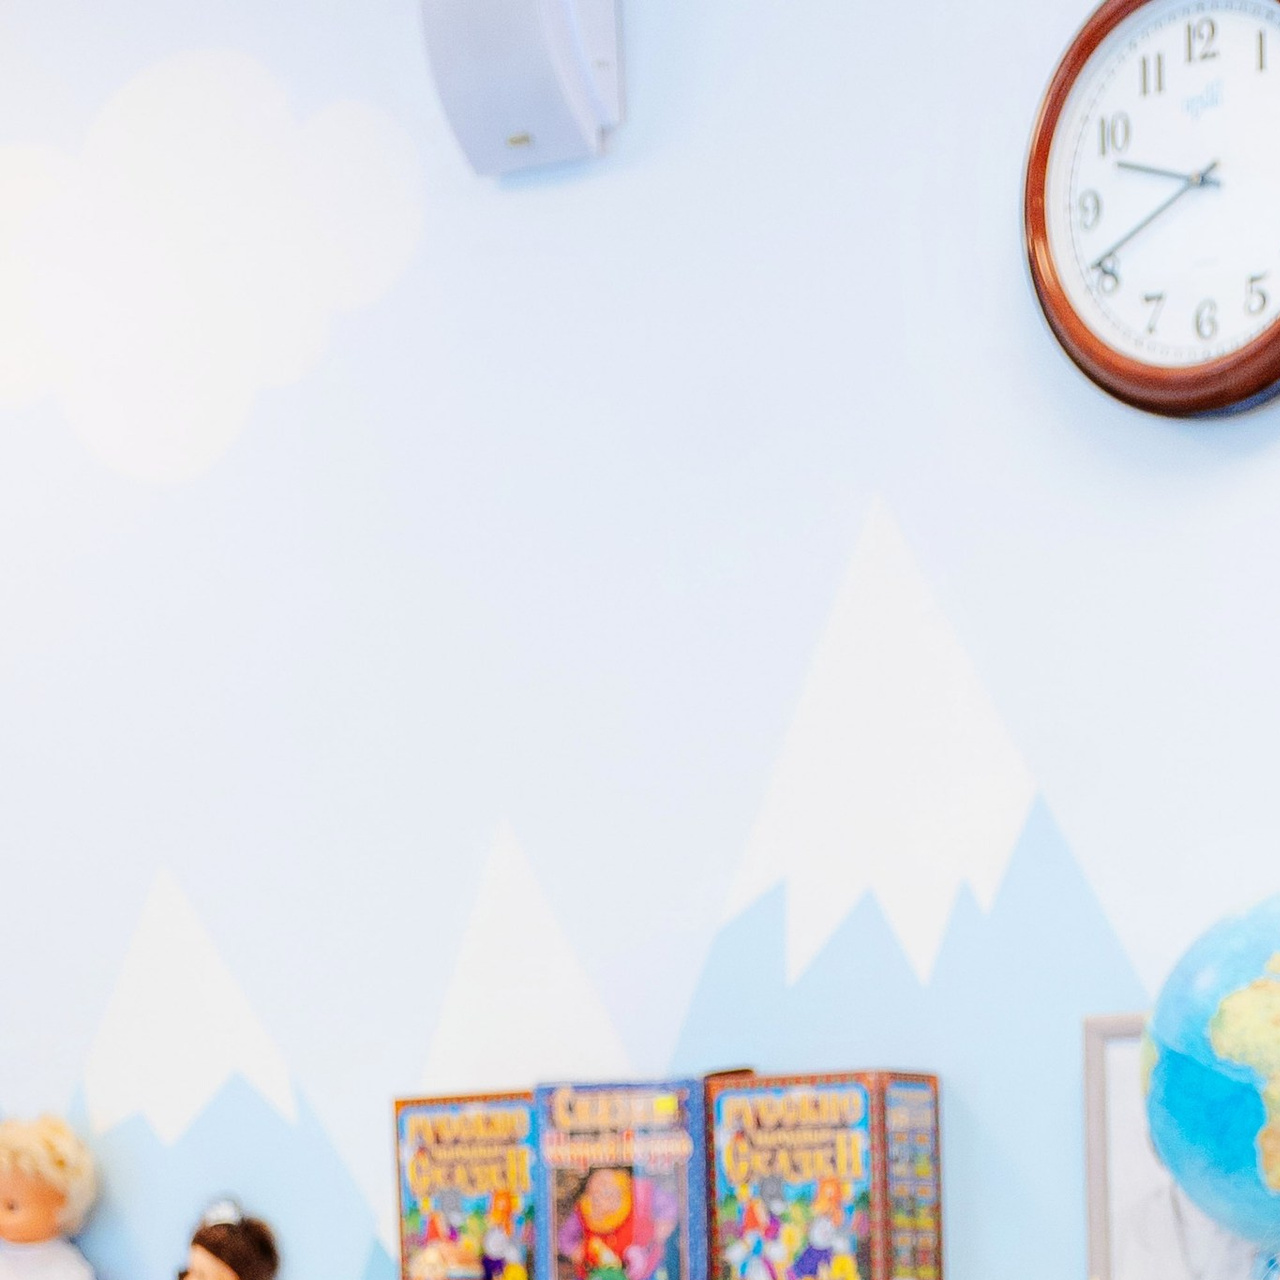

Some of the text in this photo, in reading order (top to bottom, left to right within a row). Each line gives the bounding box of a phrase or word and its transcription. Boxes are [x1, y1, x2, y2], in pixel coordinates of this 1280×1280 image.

[1184, 18, 1220, 63] 12
[1256, 29, 1266, 72] 1
[1139, 52, 1165, 97] 11
[1099, 113, 1130, 156] 10
[1080, 190, 1100, 231] 9
[1097, 252, 1120, 293] 8
[1142, 293, 1166, 333] 7
[1246, 275, 1270, 315] 5
[1194, 299, 1218, 340] 6
